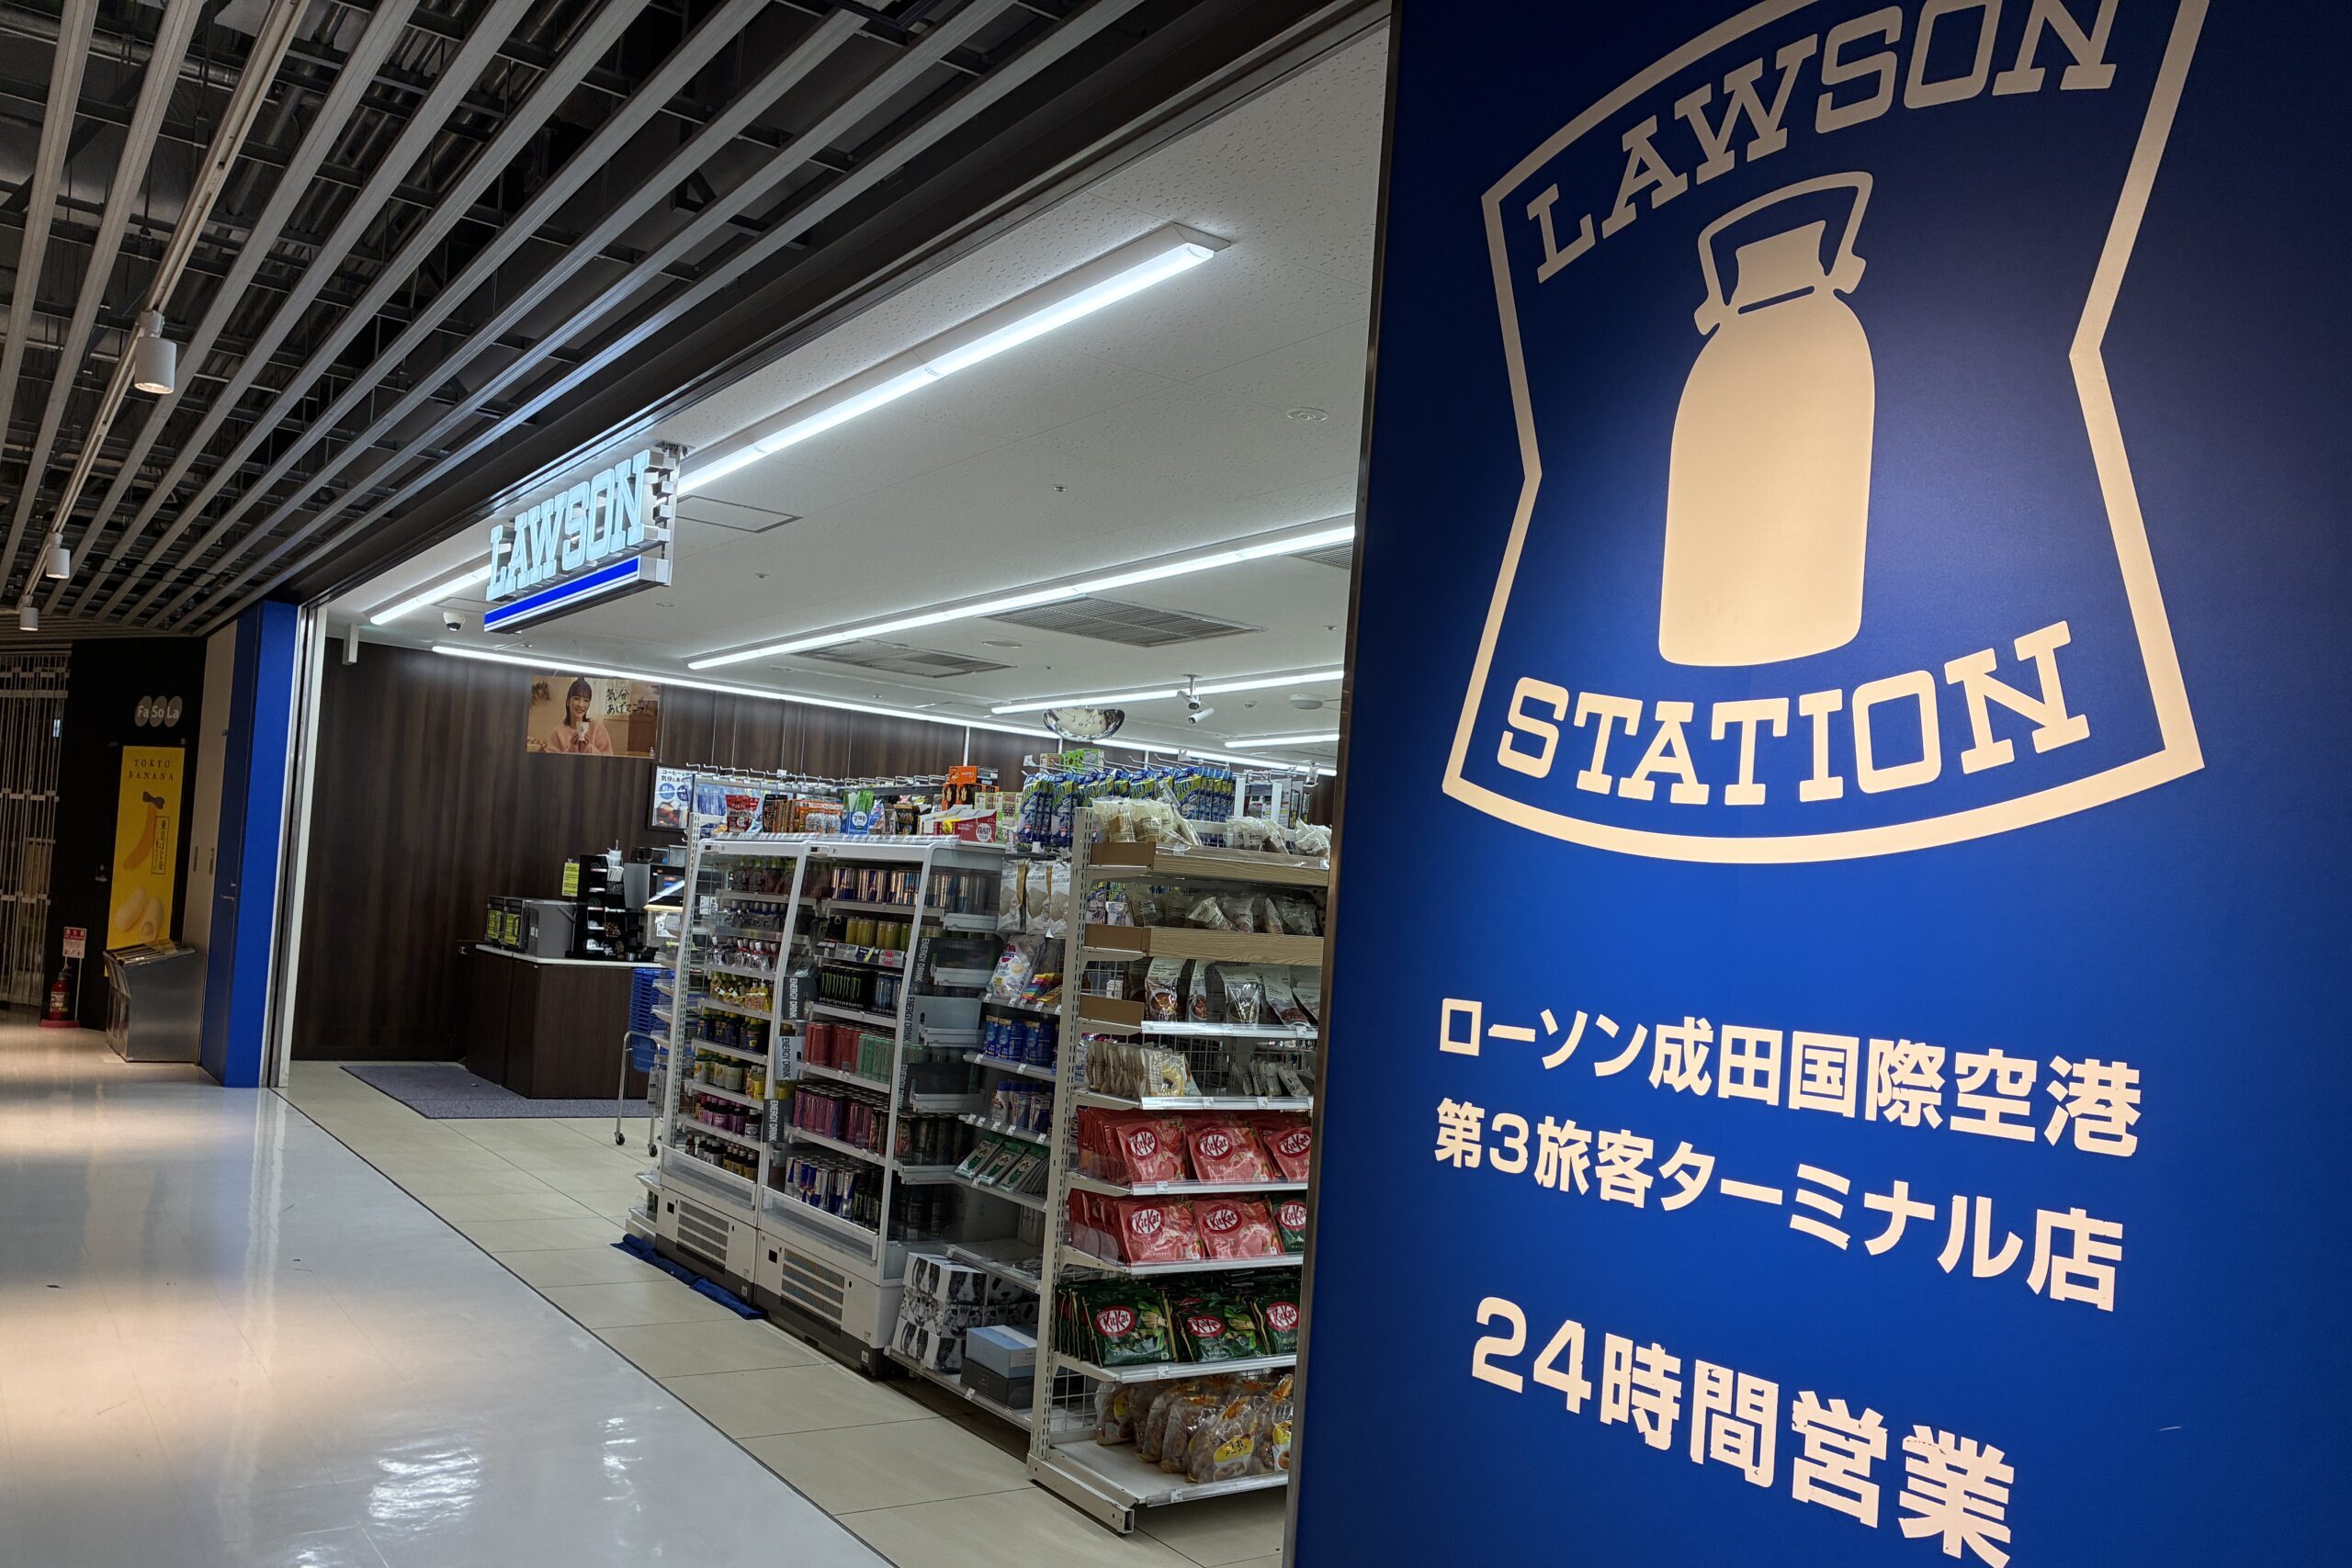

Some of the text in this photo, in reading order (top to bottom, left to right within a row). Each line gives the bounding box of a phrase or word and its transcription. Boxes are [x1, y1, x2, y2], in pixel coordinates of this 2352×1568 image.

[1526, 0, 2117, 284] LAWSON
[486, 449, 650, 602] LAWSON
[606, 688, 630, 703] 気分
[1497, 620, 2091, 806] STATION
[129, 771, 175, 781] BANANA
[134, 759, 171, 769] TOKYO
[914, 938, 931, 982] ENERGY DRINK
[789, 977, 798, 1019] ENERGY DRINK
[903, 996, 915, 1043] ENERGY DRINK
[782, 1037, 791, 1078] ENERGY DRINK
[1438, 998, 2143, 1158] ローソン成田国際空港
[768, 1100, 779, 1142] ENERGY DRINK
[1133, 1132, 1156, 1156] KitKat
[1202, 1134, 1227, 1156] KitKat
[1283, 1134, 1310, 1155] KitKat
[1209, 1210, 1237, 1232] KitKat
[1434, 1098, 2124, 1312] 第3旅客ターミナル店
[1135, 1210, 1162, 1235] KitKat
[1102, 1310, 1130, 1332] KitKat
[1193, 1317, 1220, 1334] KitKat
[1272, 1305, 1298, 1328] KitKat
[1471, 1296, 2016, 1568] 24時間営業
